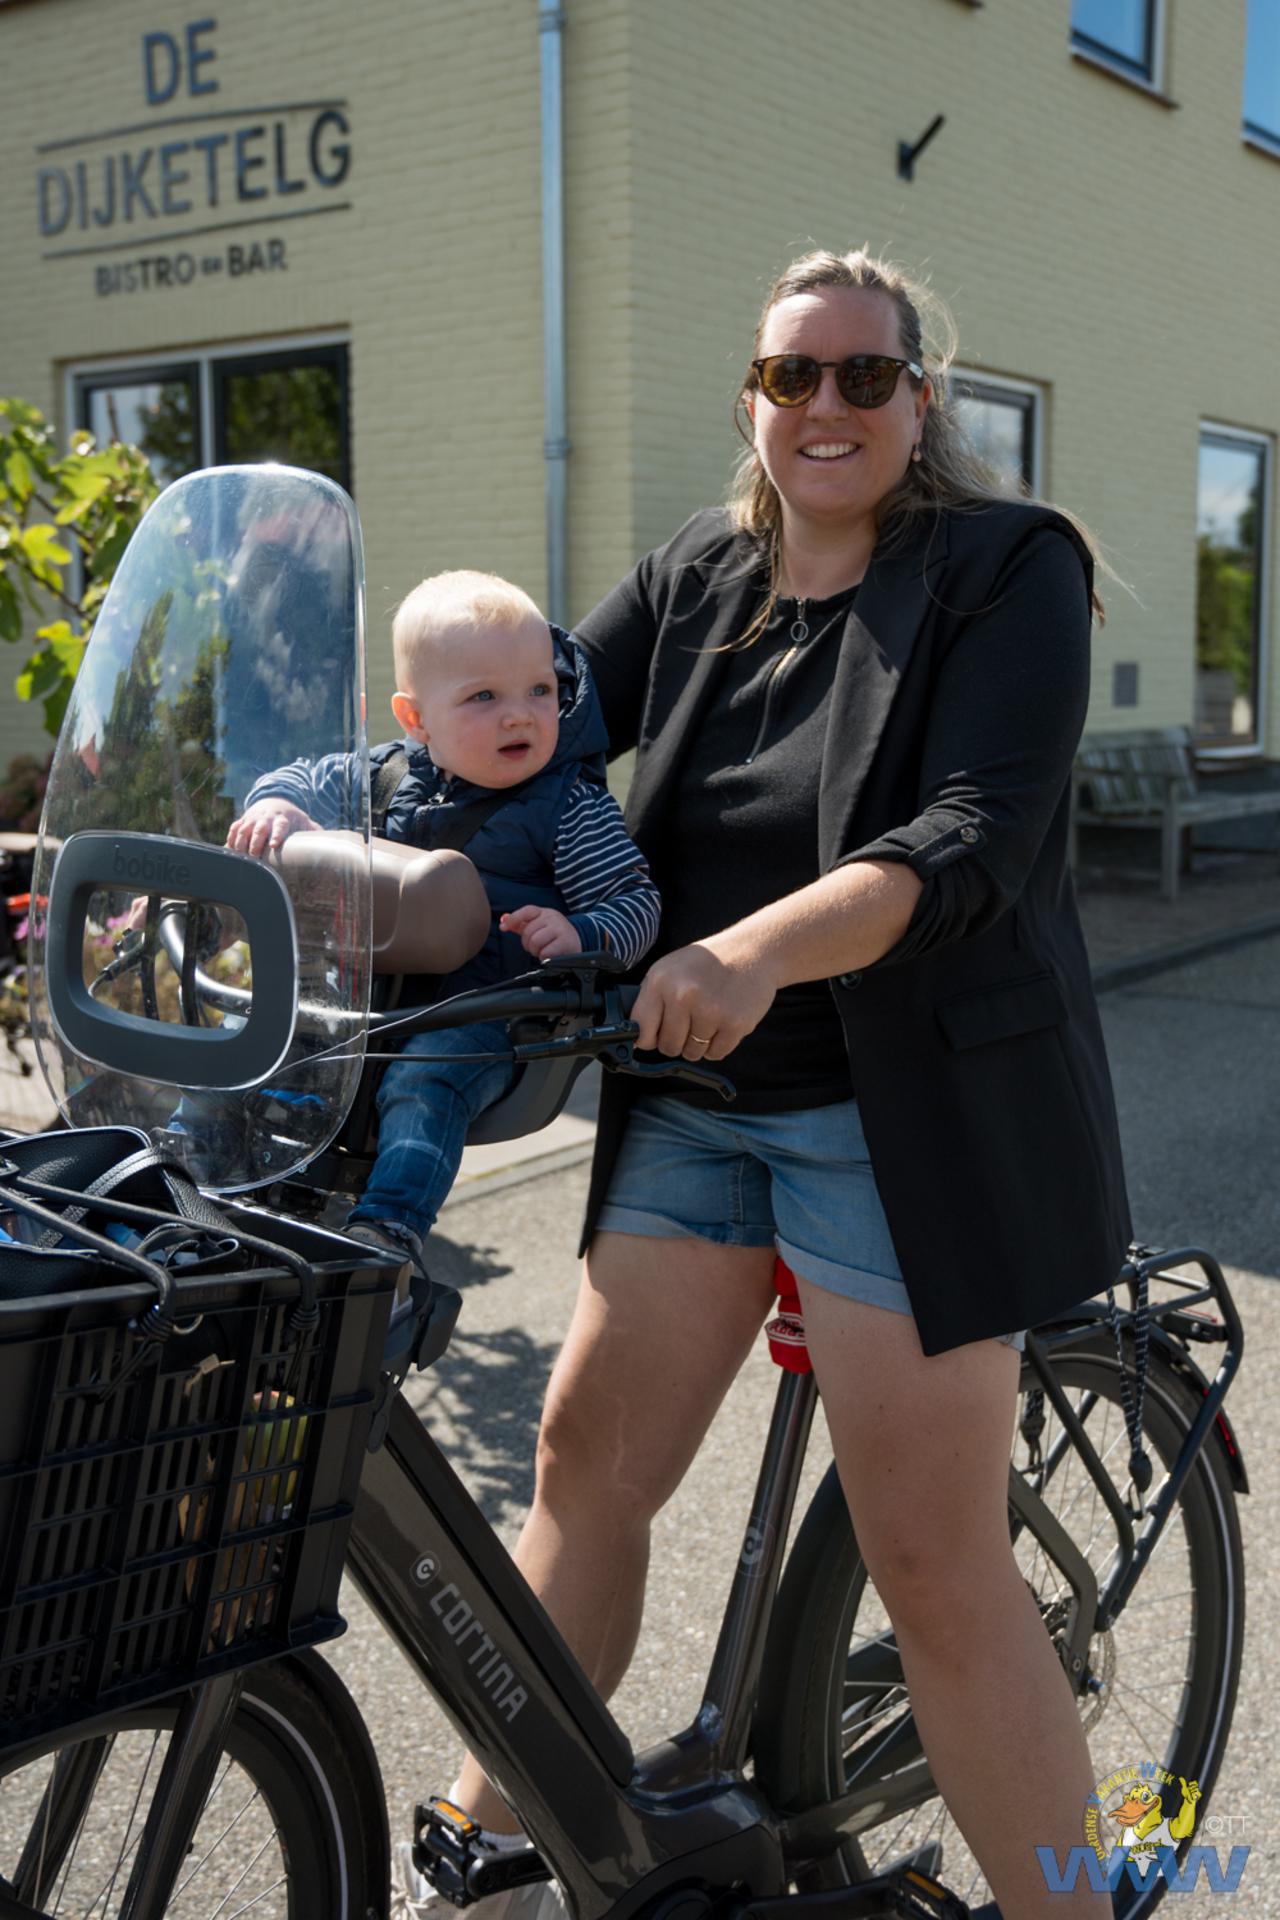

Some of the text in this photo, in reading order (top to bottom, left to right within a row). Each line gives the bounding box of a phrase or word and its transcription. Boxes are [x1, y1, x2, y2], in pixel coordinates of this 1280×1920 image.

[142, 18, 219, 107] DE
[36, 109, 352, 237] DIJKETELG
[96, 252, 196, 297] BISTRO
[228, 238, 288, 278] BAR
[113, 845, 192, 886] bobike
[430, 1582, 529, 1724] CORTINA
